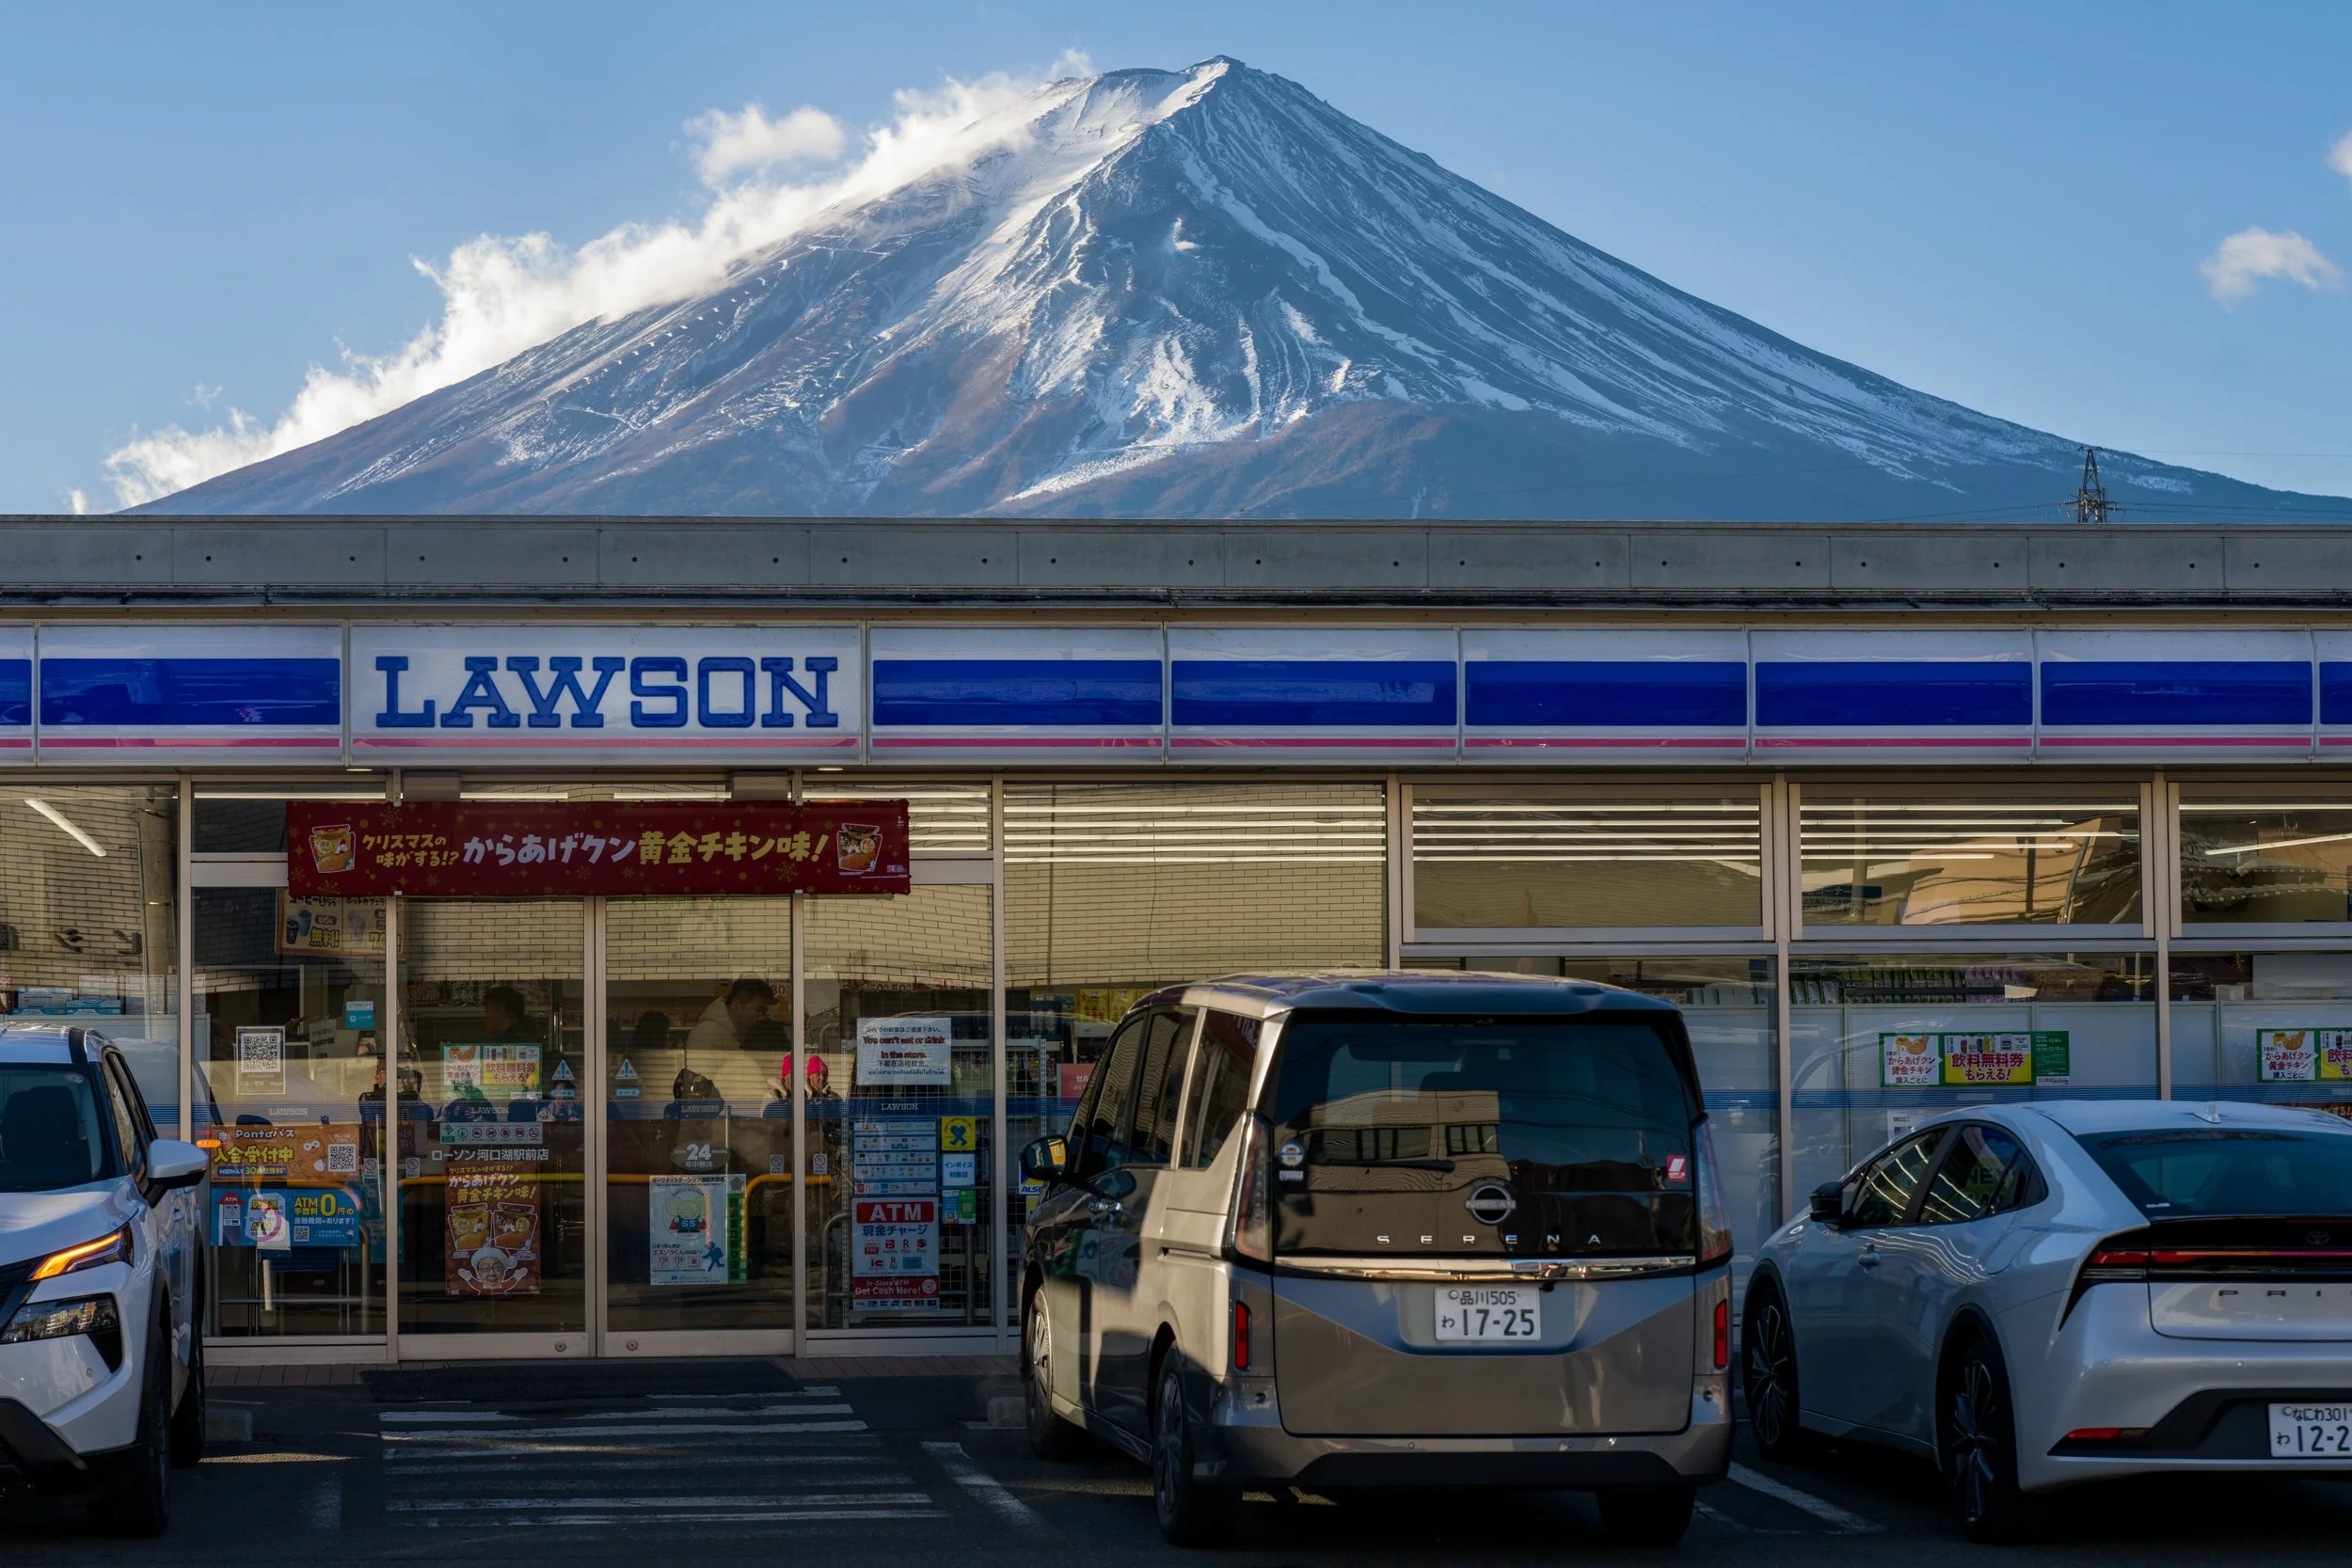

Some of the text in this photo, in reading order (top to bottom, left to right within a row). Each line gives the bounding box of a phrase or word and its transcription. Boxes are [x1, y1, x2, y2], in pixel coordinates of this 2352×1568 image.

[375, 656, 838, 728] LAWSON
[362, 833, 447, 850] クリスマスの
[376, 849, 459, 868] 味がする!?
[863, 1036, 878, 1044] You
[925, 1036, 946, 1044] drink
[889, 1050, 903, 1058] the
[1951, 1052, 2025, 1068] 飲料無料券
[2265, 1052, 2312, 1061] からあげクン
[1888, 1055, 1936, 1066] からあげクン
[2268, 1061, 2309, 1070] 黄金チキン
[485, 1062, 536, 1072] 飲料無料券
[1891, 1066, 1932, 1075] 黄金チキン
[1964, 1068, 2011, 1081] もらえる!
[235, 1129, 294, 1138] Pontaパス
[213, 1146, 294, 1164] 入会受付中
[432, 1148, 549, 1161] ローソン 河口湖駅前店
[686, 1144, 711, 1161] 24
[449, 1173, 519, 1187] からあげクン
[456, 1185, 537, 1204] 黄金チキン味!
[294, 1197, 318, 1208] ATM
[294, 1208, 319, 1216] 手数料
[869, 1204, 922, 1222] ATM
[863, 1225, 928, 1236] 現金チャージ
[1376, 1235, 1601, 1244] SERENA
[855, 1287, 921, 1295] Get Cash Here!
[1441, 1309, 1534, 1336] わ 17-25
[2277, 1425, 2350, 1451] わ 12-2
